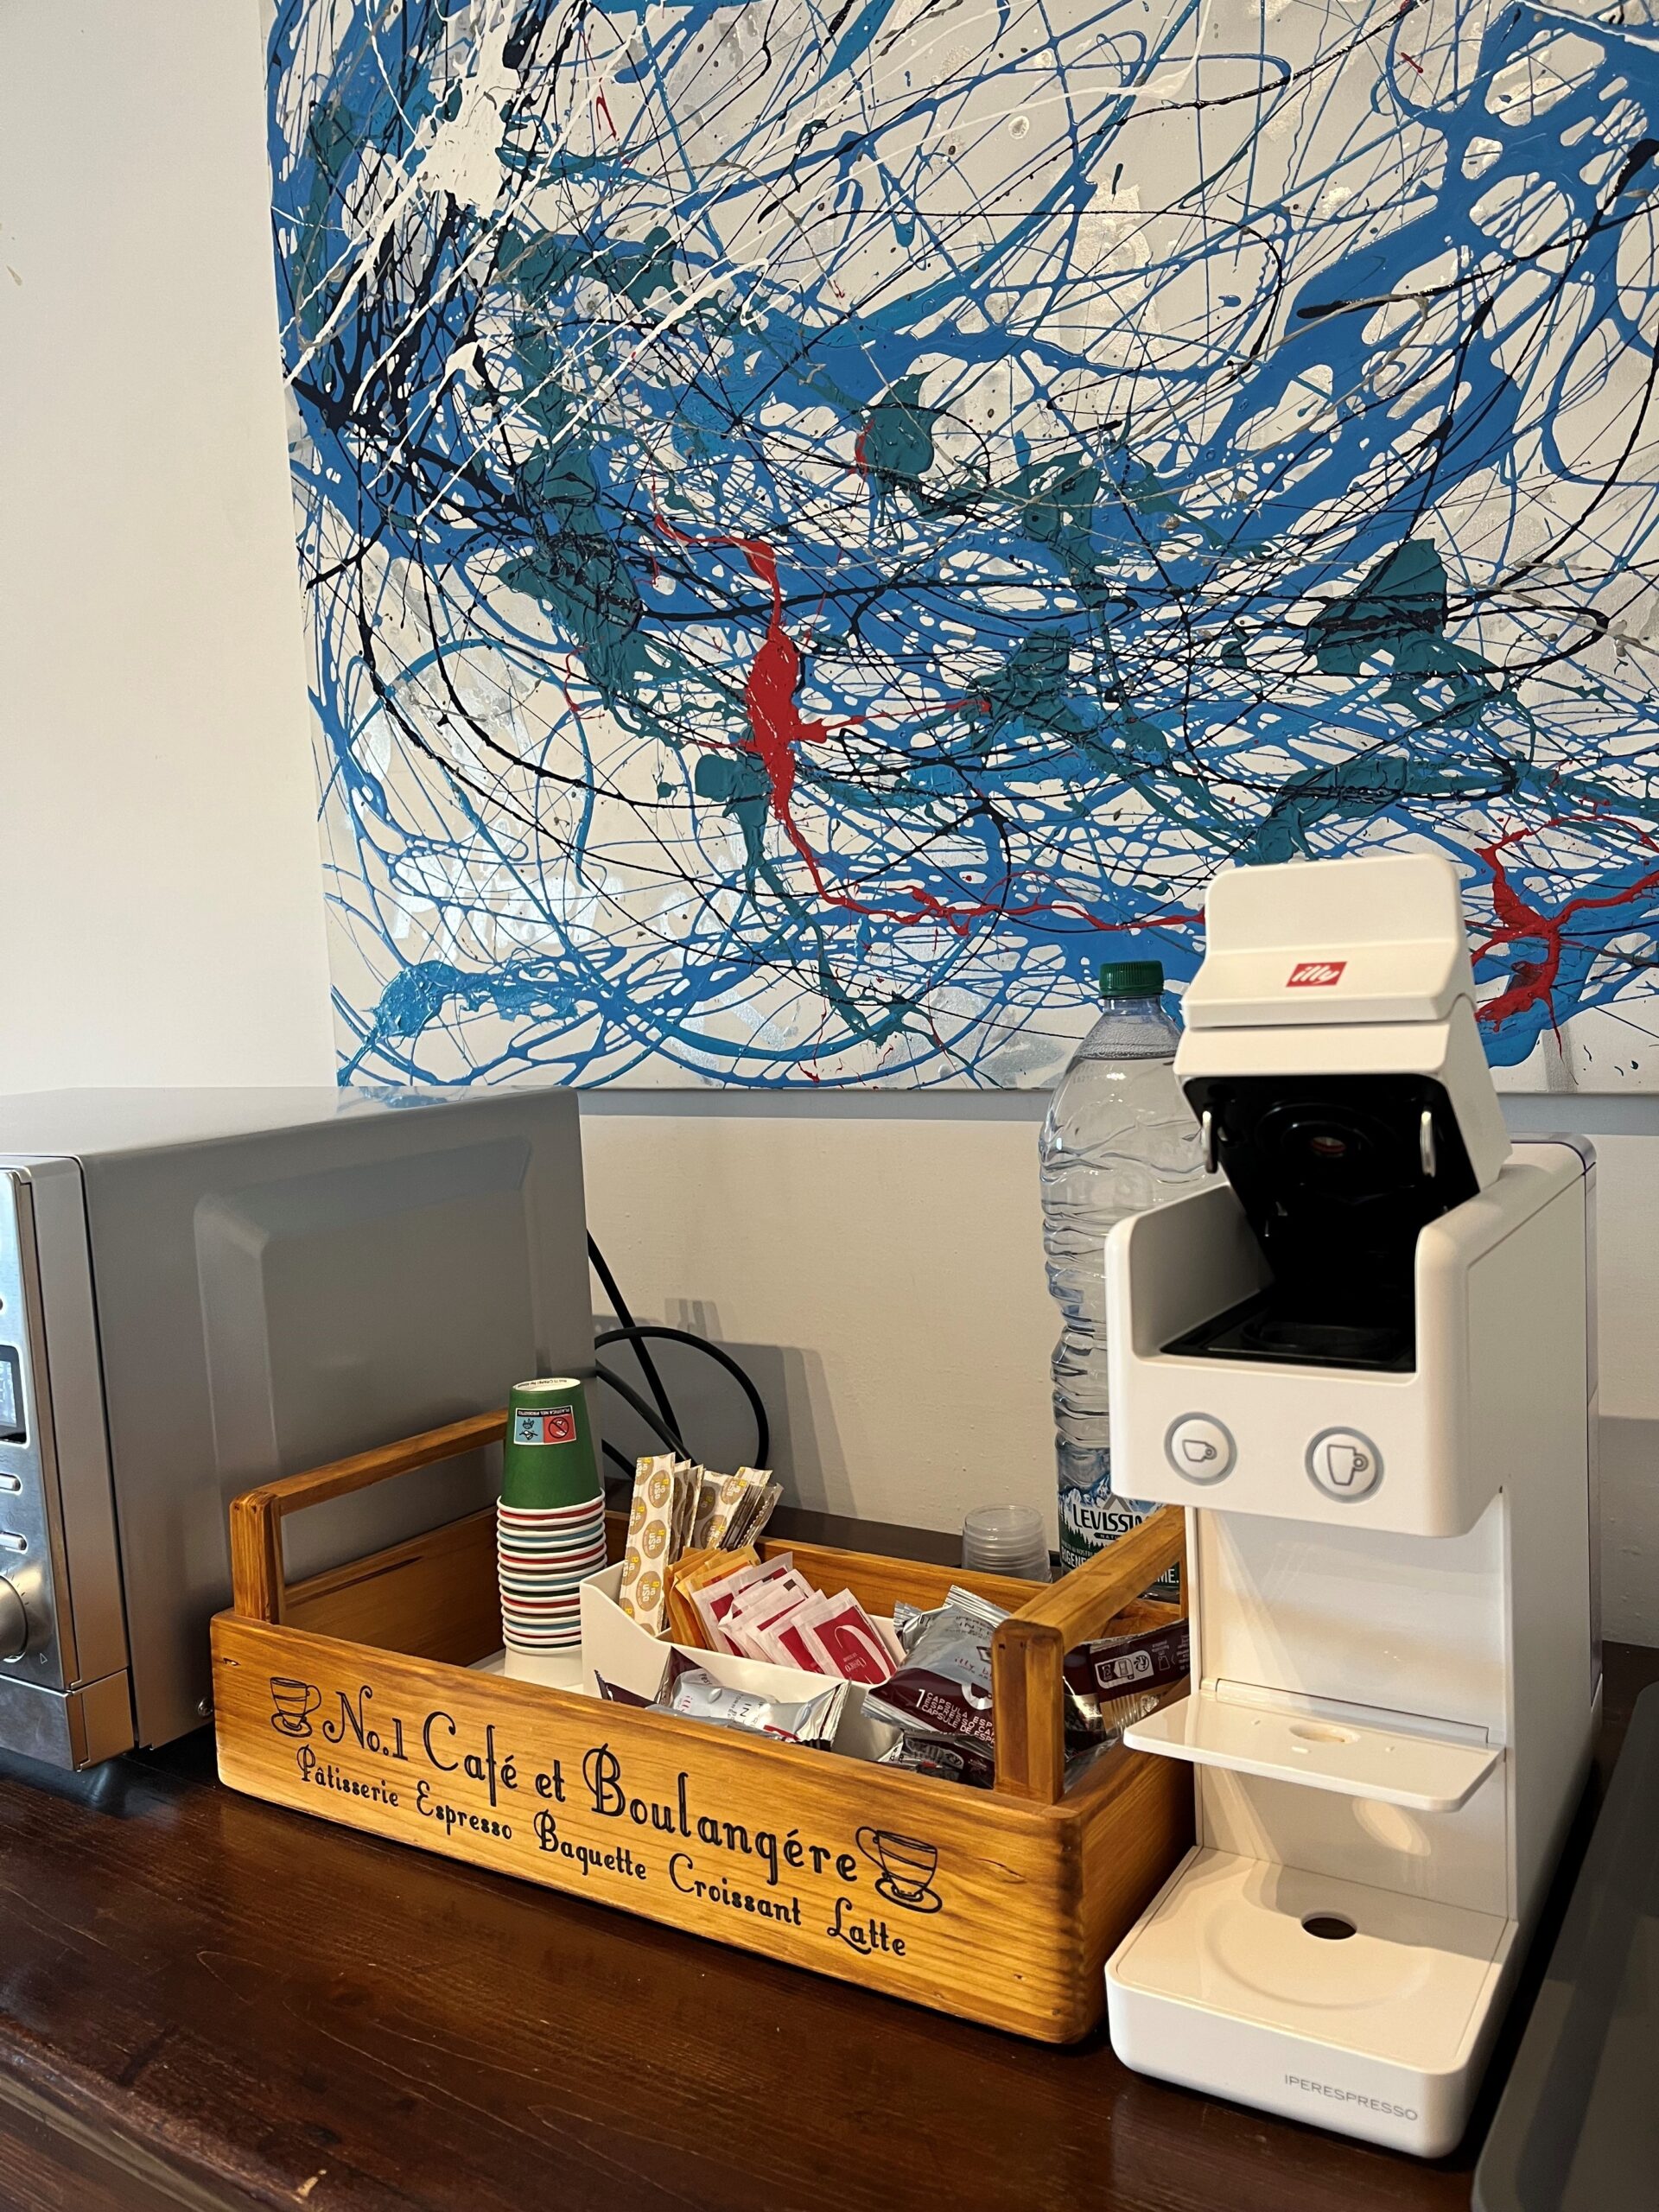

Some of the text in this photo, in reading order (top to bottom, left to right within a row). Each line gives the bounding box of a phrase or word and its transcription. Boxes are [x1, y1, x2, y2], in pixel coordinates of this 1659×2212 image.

[1291, 965, 1342, 985] illy
[916, 1688, 994, 1729] 1 CAPSULA ESP
[921, 1704, 960, 1729] CAPSULE
[959, 1725, 972, 1735] DE
[925, 1697, 976, 1729] ESPRESSO
[423, 1711, 518, 1808] Café
[535, 1759, 566, 1802] et
[296, 1744, 399, 1808] Pâtisserie
[416, 1780, 513, 1836] Espresso
[669, 1853, 803, 1926] Croissant
[826, 1897, 907, 1957] Latte
[1284, 2074, 1419, 2122] IPERESPRESSO
